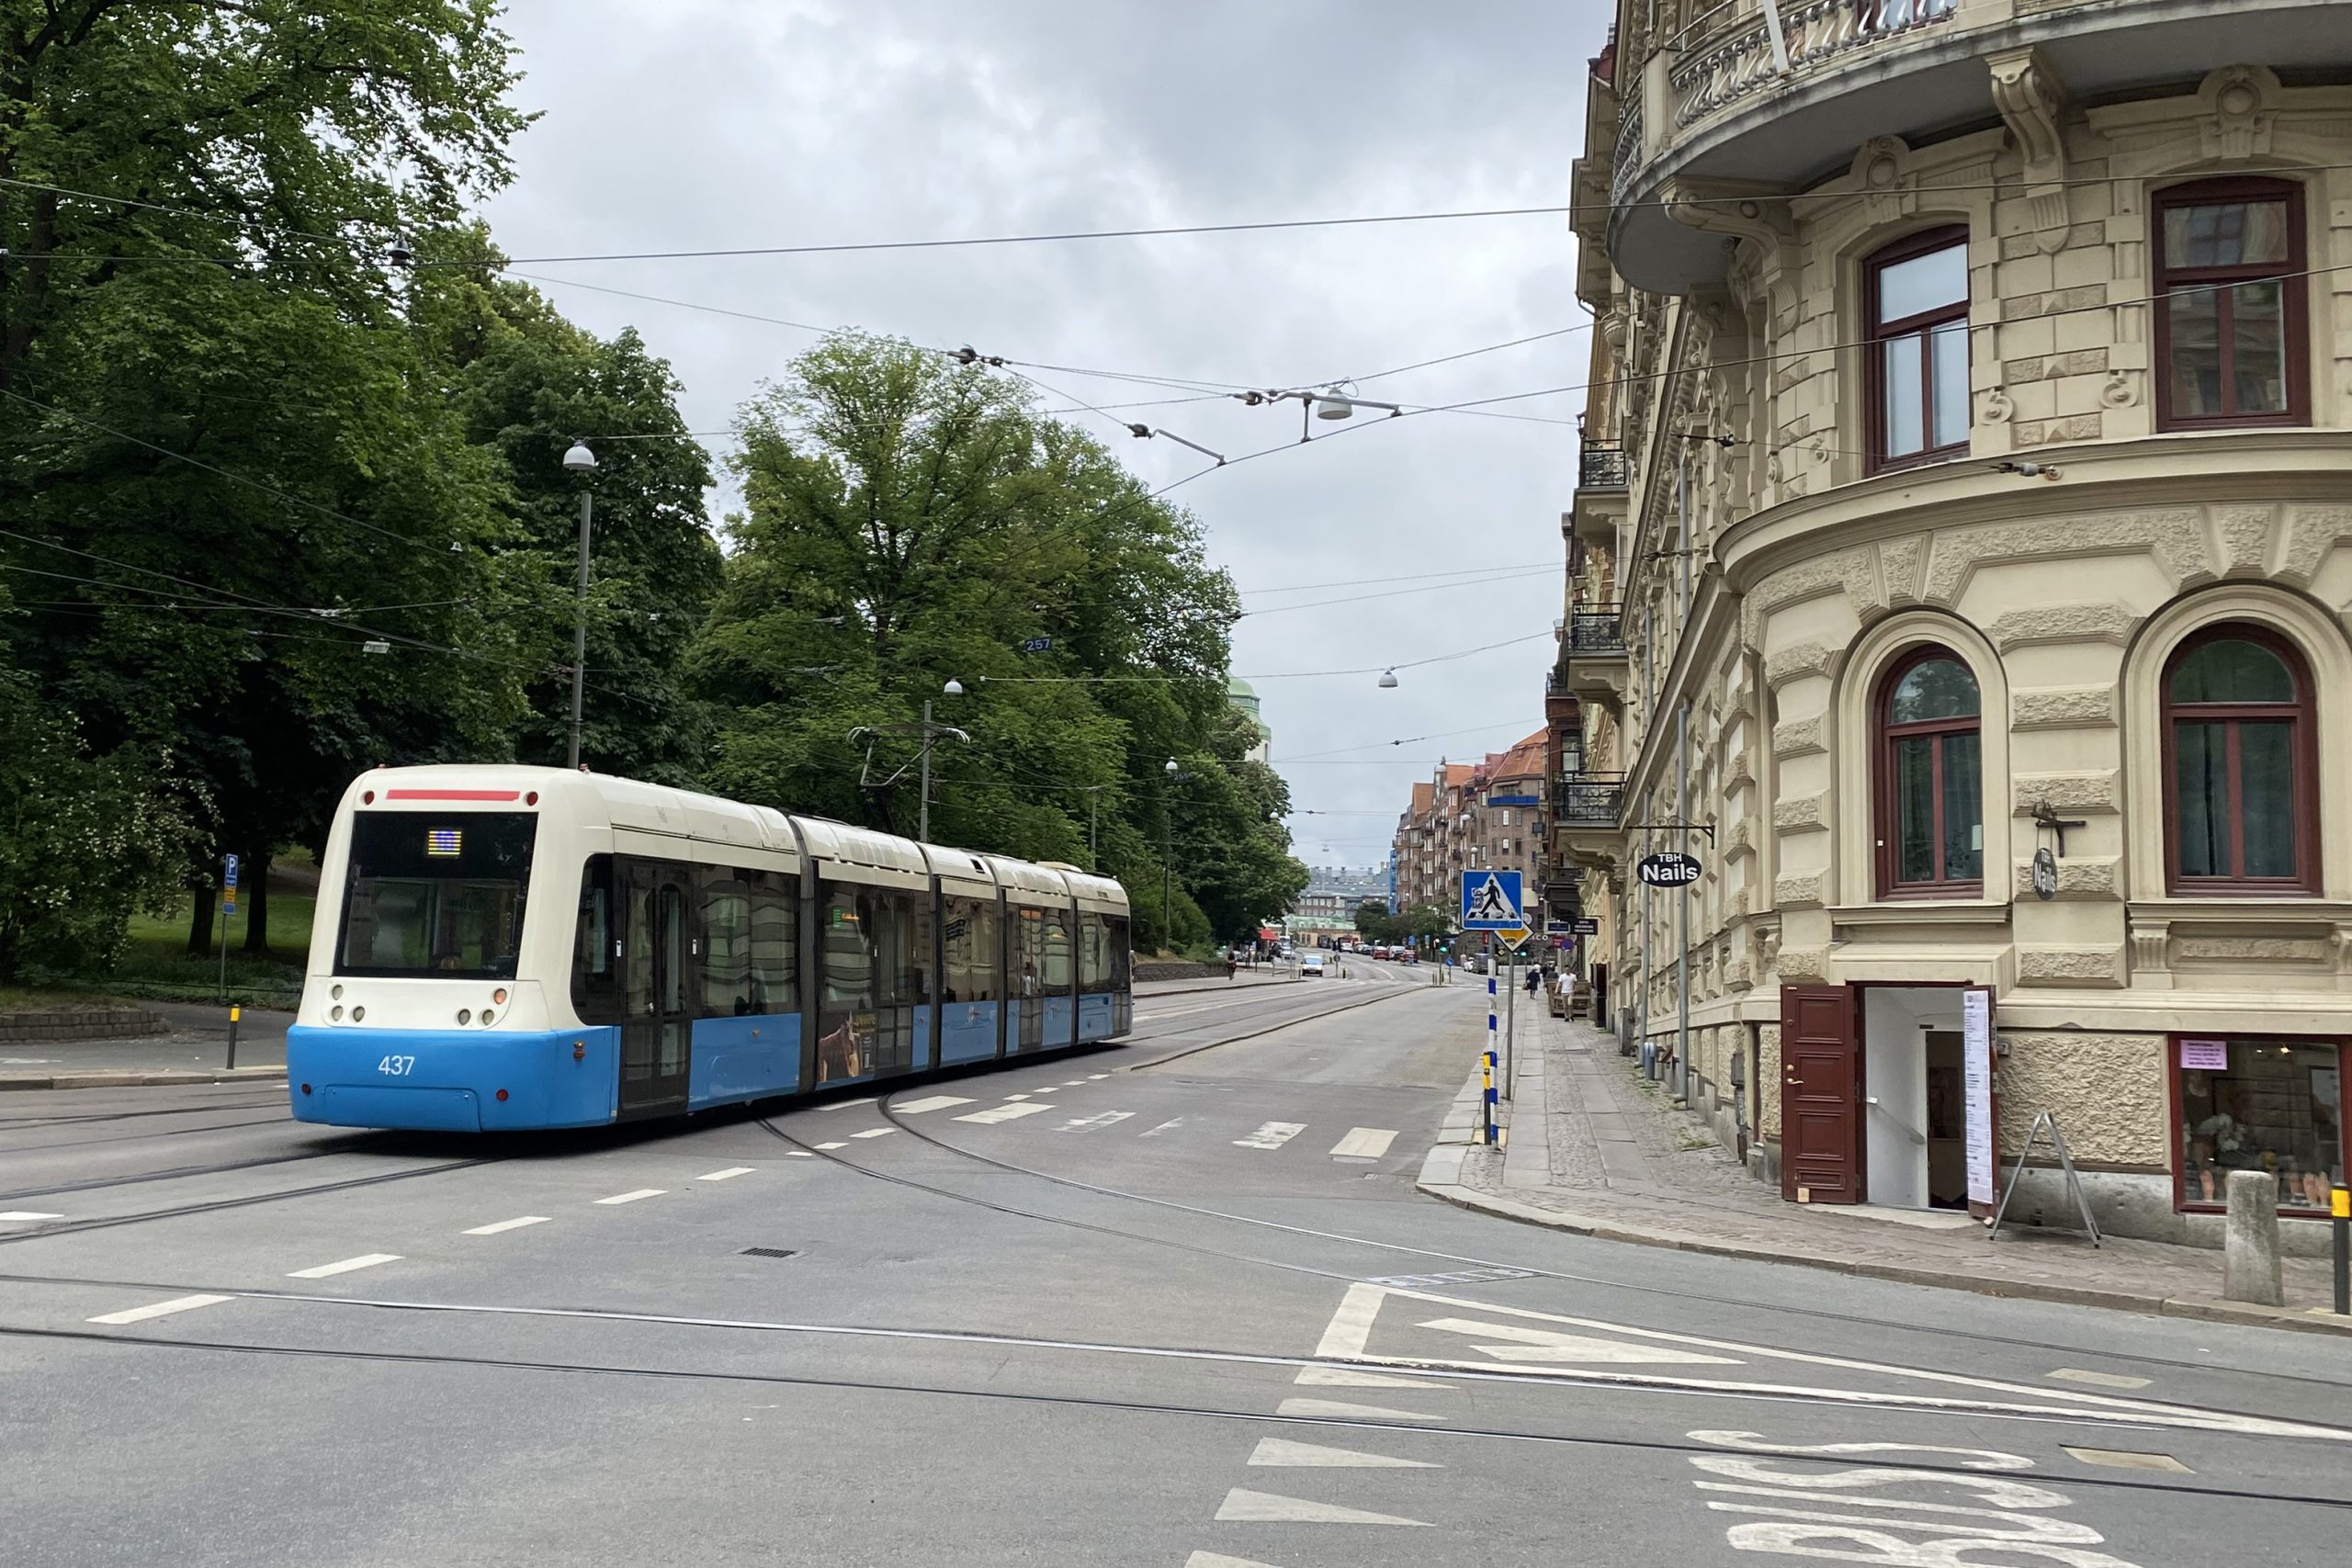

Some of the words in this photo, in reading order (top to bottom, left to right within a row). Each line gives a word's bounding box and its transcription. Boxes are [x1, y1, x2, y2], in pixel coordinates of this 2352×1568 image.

[1026, 638, 1050, 651] 257
[228, 857, 236, 874] P
[1657, 853, 1682, 863] TBH
[1643, 863, 1698, 882] Nails
[2034, 862, 2056, 893] Nails
[378, 1055, 415, 1076] 437
